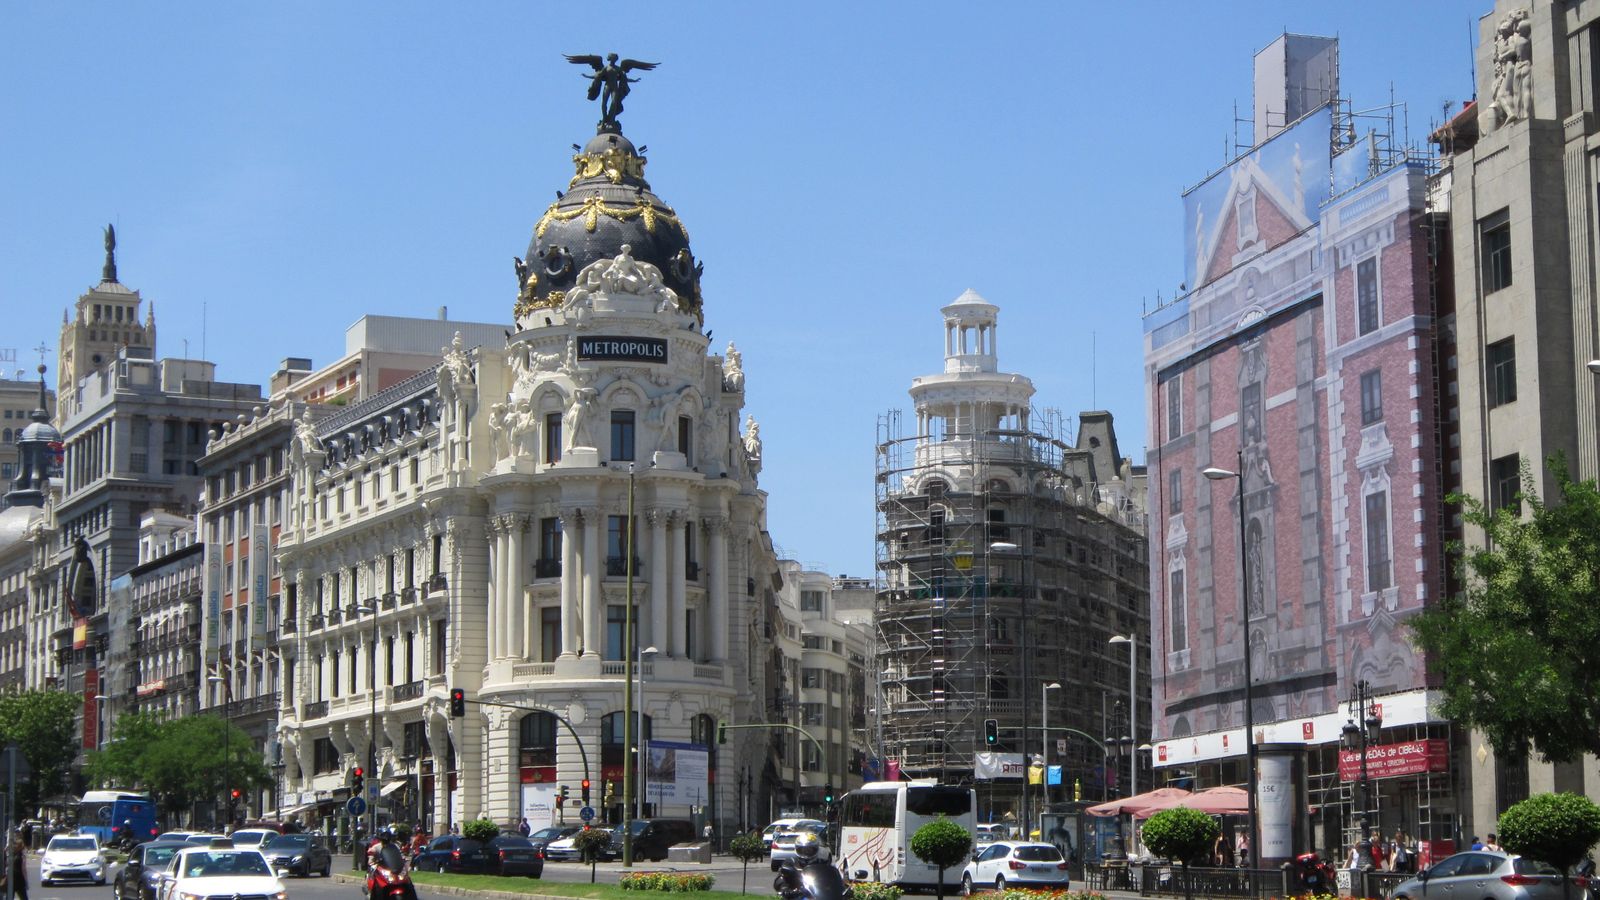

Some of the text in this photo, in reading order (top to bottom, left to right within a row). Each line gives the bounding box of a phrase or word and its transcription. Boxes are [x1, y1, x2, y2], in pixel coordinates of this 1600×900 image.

[582, 341, 664, 357] METROPOLIS
[1387, 748, 1397, 757] de
[1263, 785, 1275, 793] 15€
